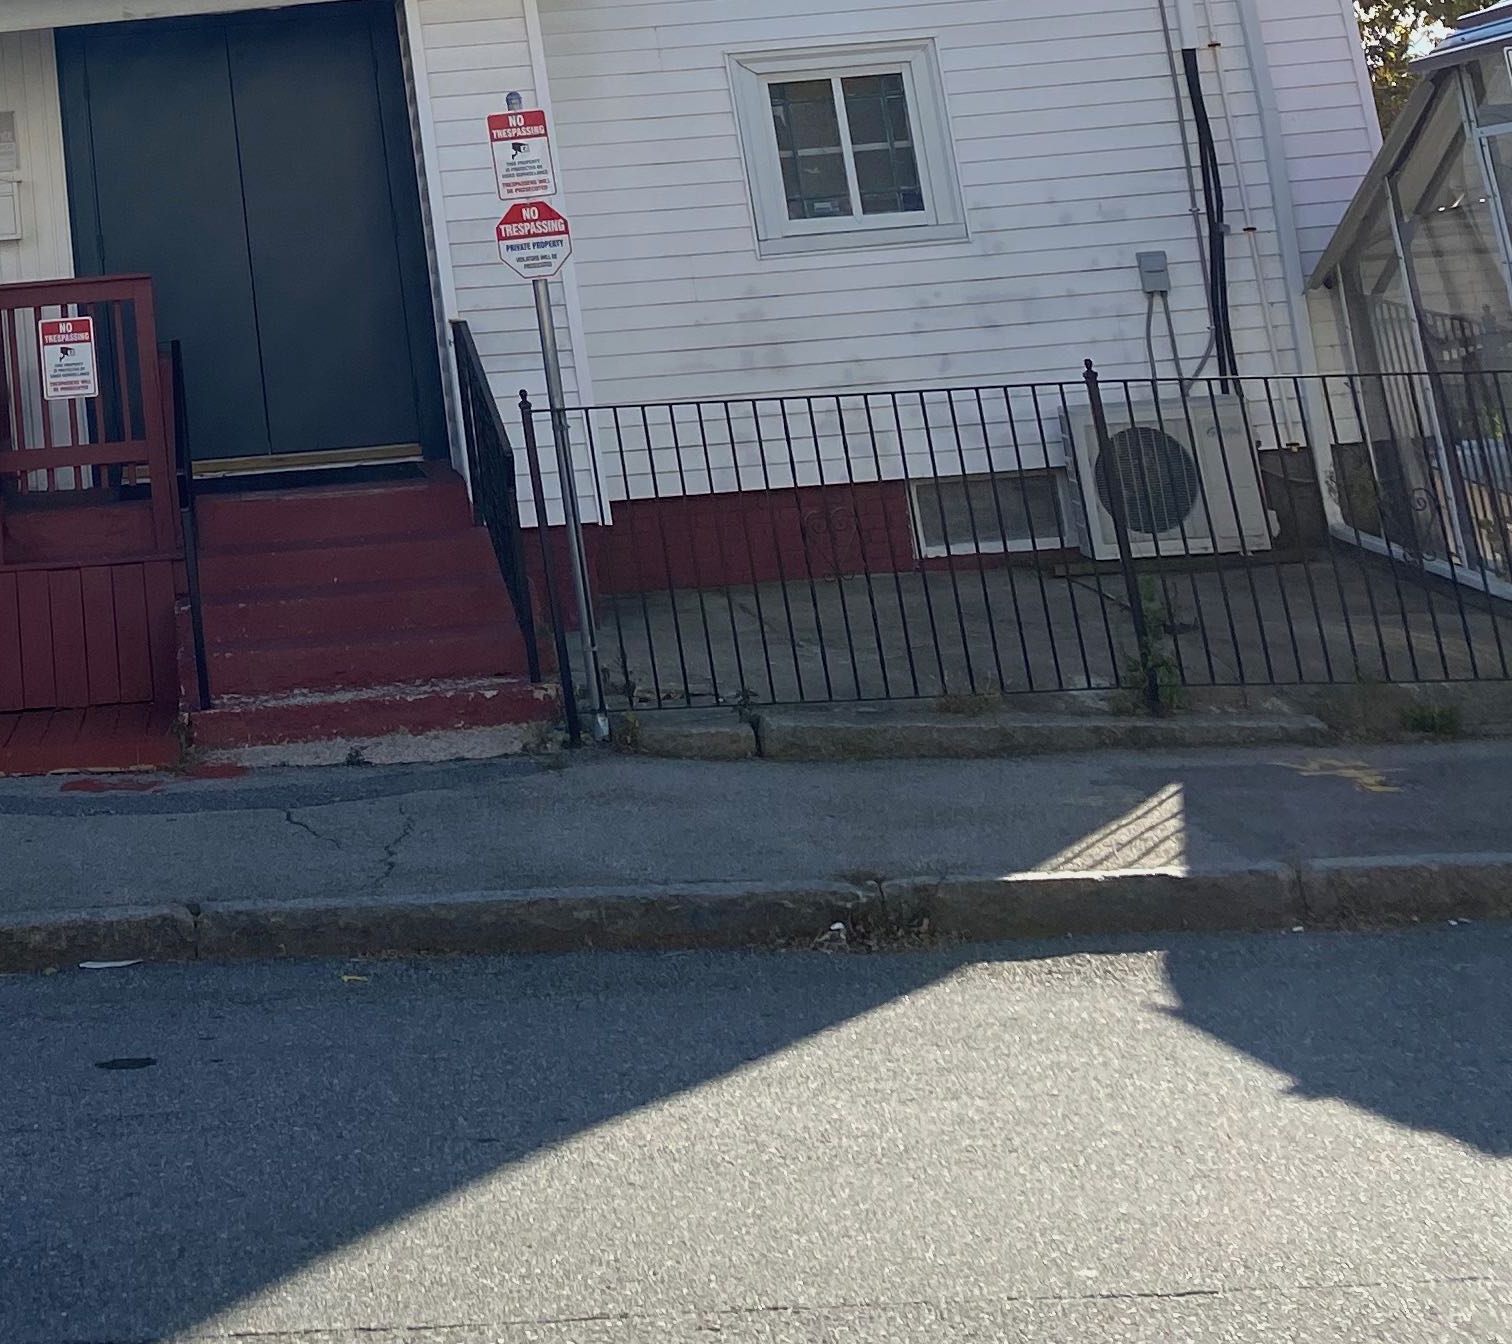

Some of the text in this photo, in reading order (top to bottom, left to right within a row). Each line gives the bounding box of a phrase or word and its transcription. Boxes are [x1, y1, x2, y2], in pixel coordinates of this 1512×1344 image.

[508, 114, 525, 127] NO
[492, 125, 545, 139] TRESPASSING
[521, 207, 539, 220] NO
[499, 219, 565, 237] TRESPASSING
[506, 239, 564, 252] PRIVATE PROPERTY
[59, 322, 73, 334] NO
[44, 332, 90, 344] TRESPASSING
